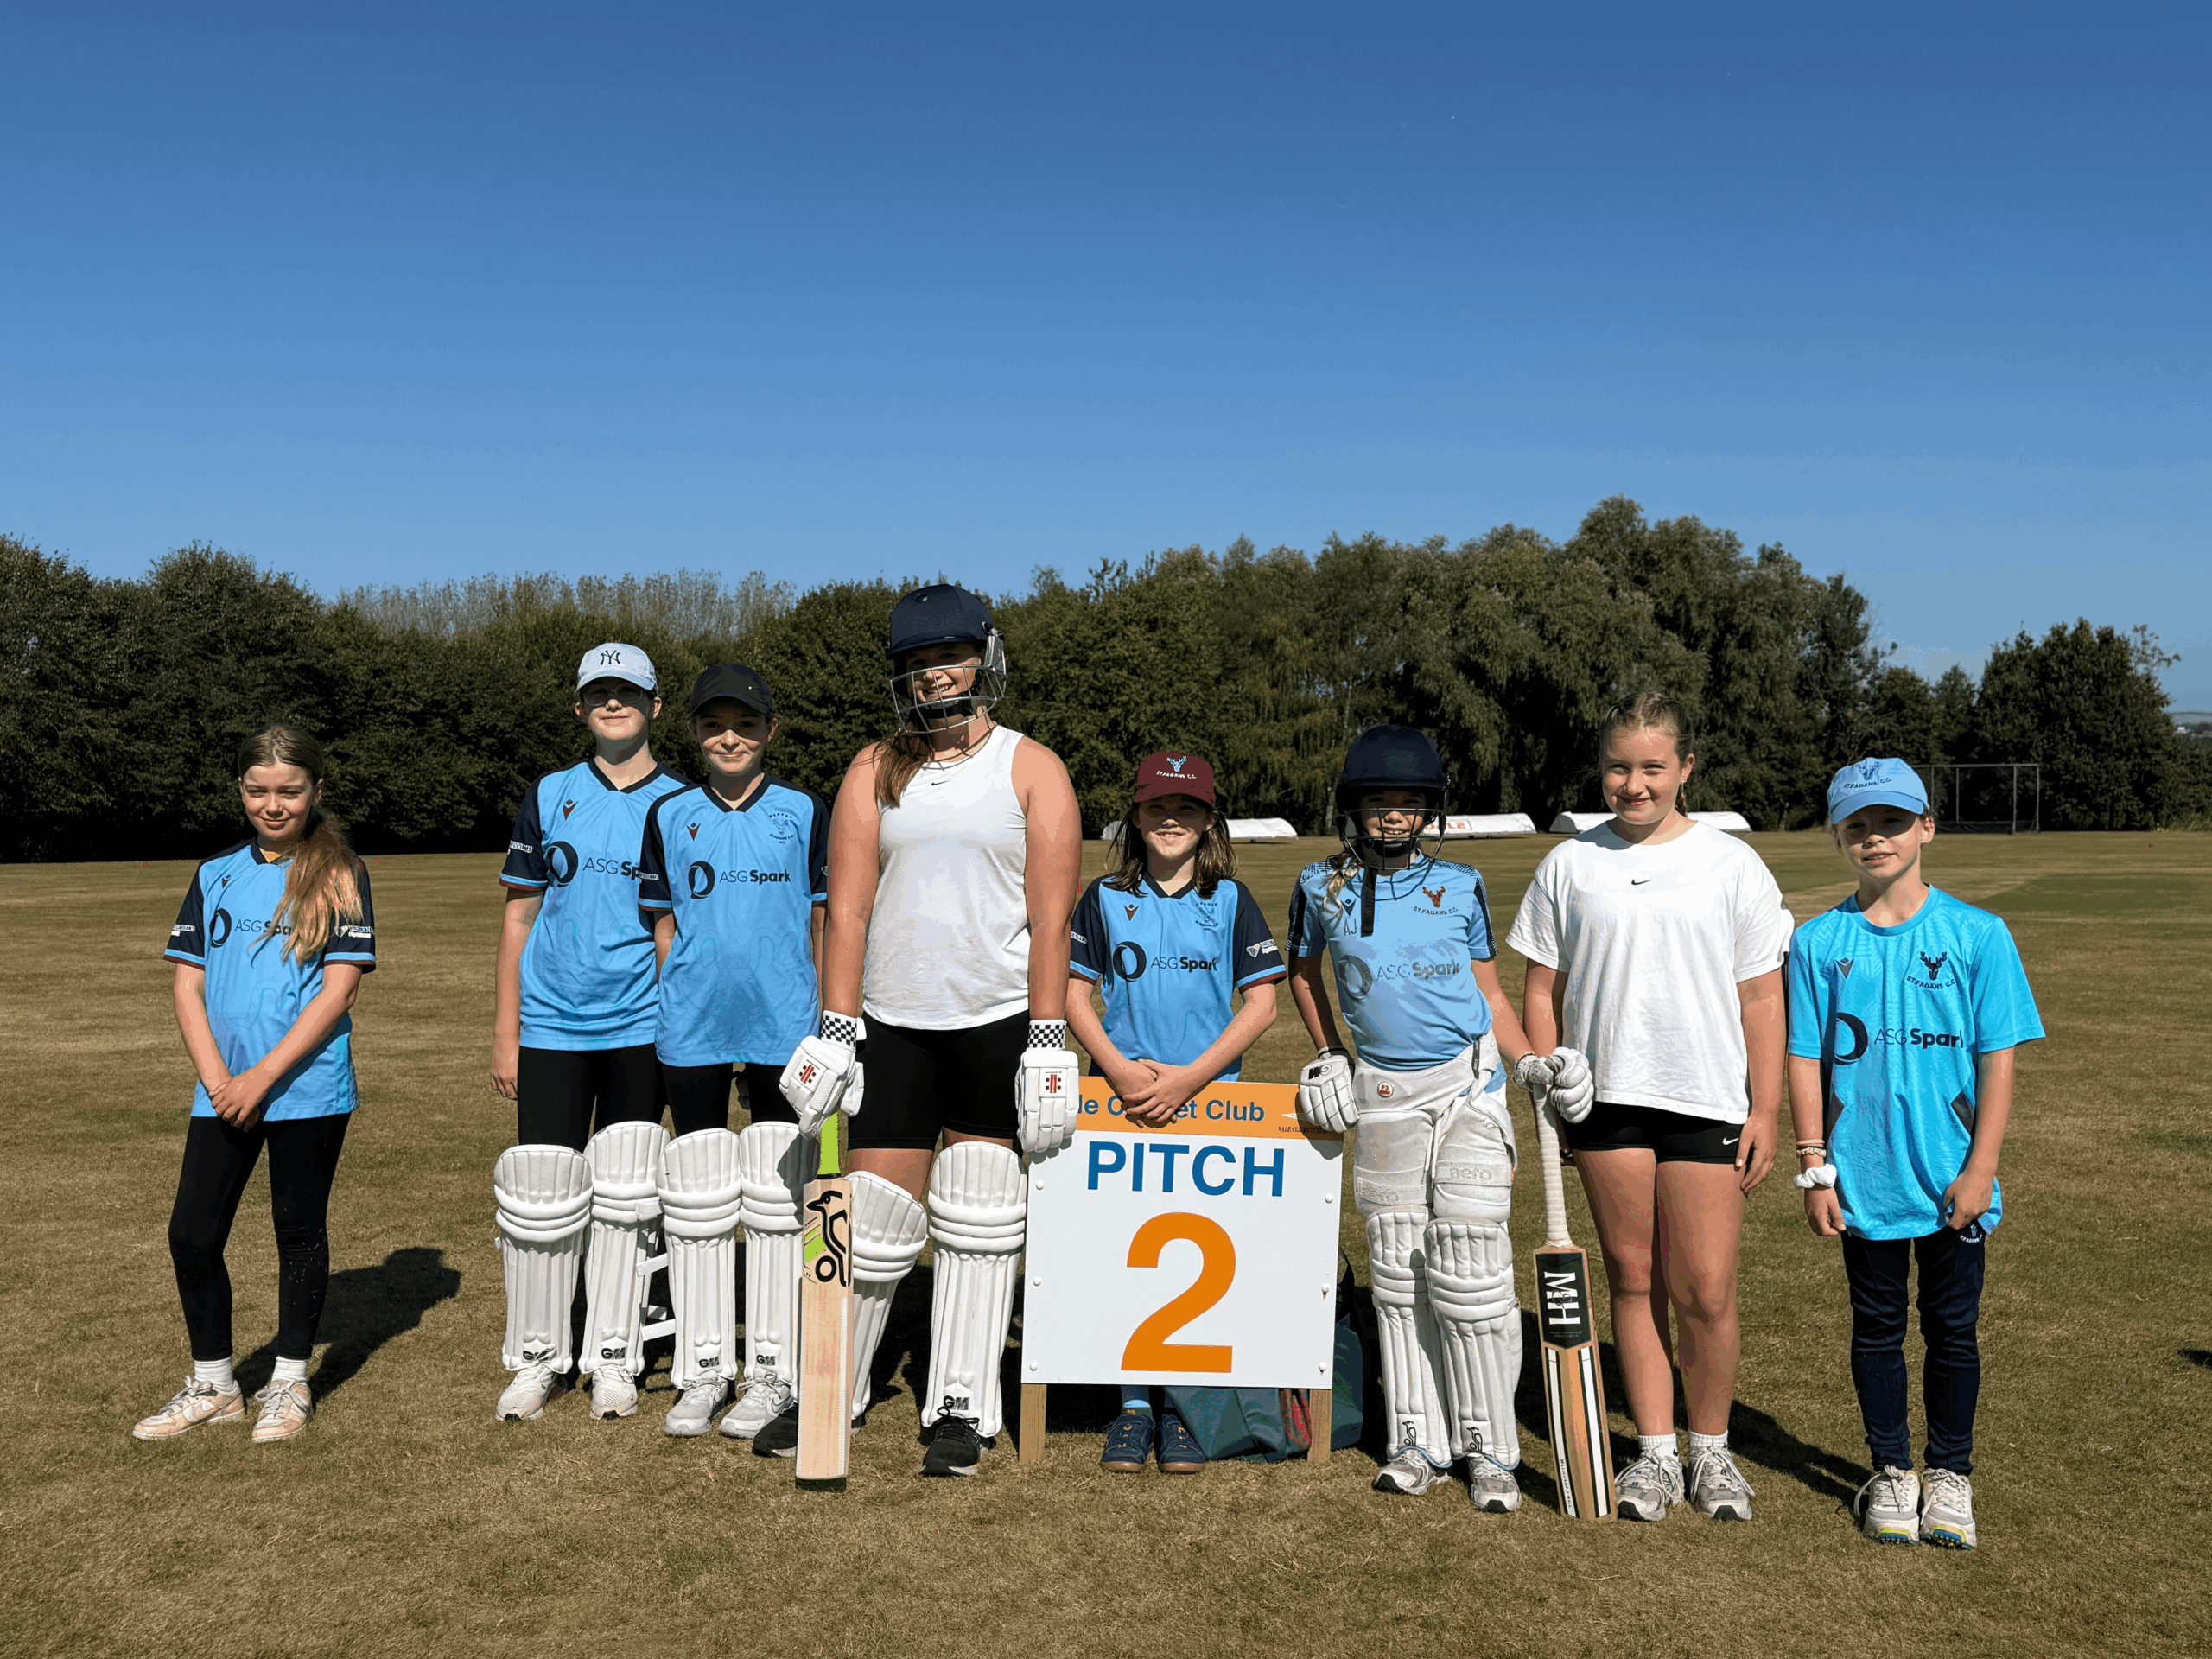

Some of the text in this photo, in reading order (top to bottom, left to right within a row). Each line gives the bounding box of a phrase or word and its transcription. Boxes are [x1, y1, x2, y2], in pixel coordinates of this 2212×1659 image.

[600, 649, 621, 666] NY
[582, 856, 619, 875] ASG
[719, 868, 791, 886] ASG Spark
[234, 918, 292, 937] ASG Spa
[1344, 918, 1357, 936] AJ
[1150, 956, 1179, 970] ASG
[1376, 957, 1460, 982] ASG Spark
[1873, 1027, 1908, 1046] ASG
[1206, 1098, 1265, 1122] Club
[1087, 1140, 1285, 1198] PITCH
[1121, 1211, 1236, 1374] 2
[601, 1346, 626, 1361] GM
[698, 1355, 721, 1369] GM
[756, 1353, 777, 1366] GM
[943, 1394, 971, 1411] GM
